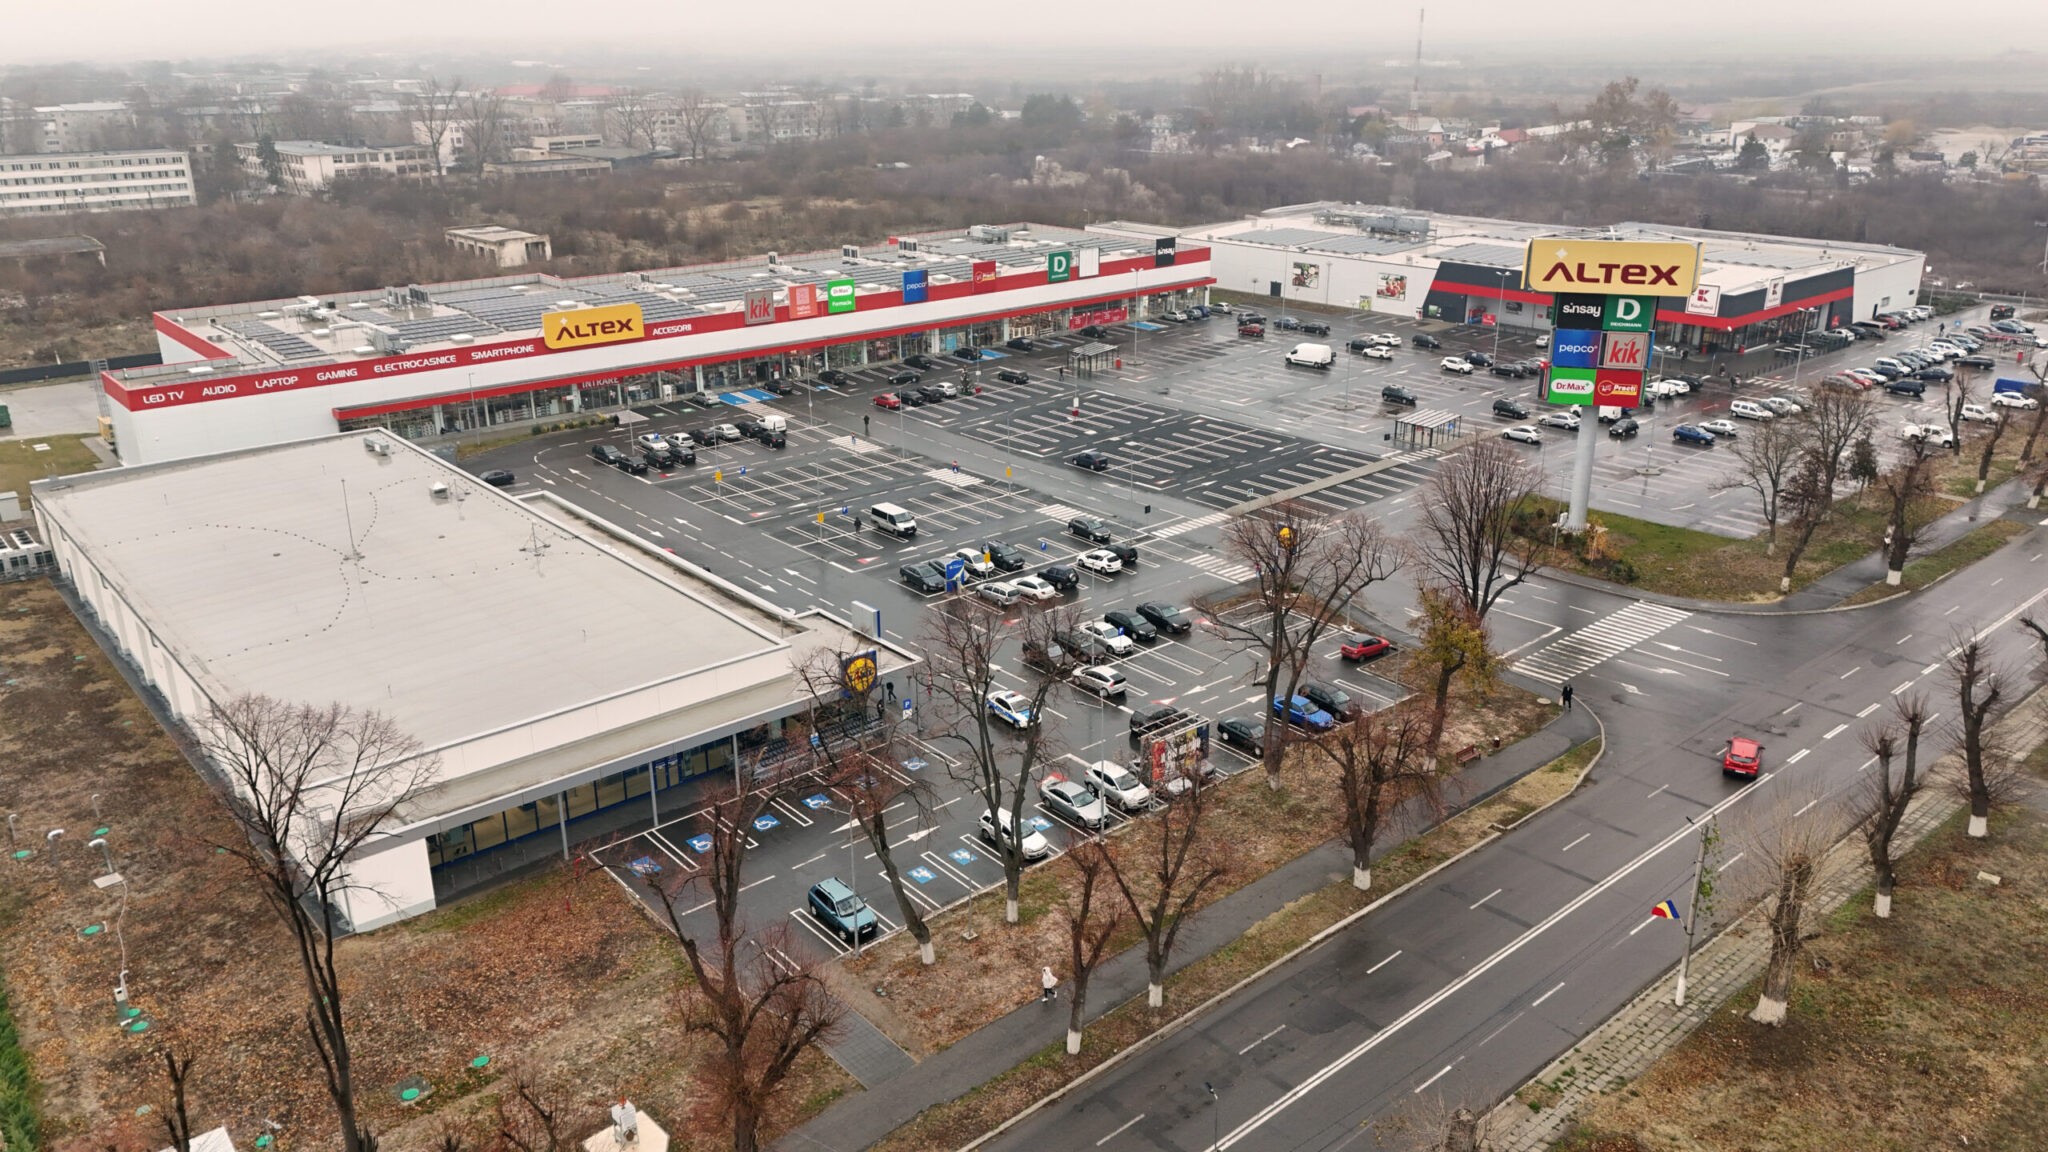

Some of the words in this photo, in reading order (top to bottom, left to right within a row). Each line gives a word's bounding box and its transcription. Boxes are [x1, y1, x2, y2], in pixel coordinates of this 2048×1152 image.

[1053, 256, 1067, 273] D
[906, 281, 926, 290] pepco
[749, 295, 771, 319] kik
[1562, 302, 1601, 317] sinsay
[1616, 298, 1641, 321] D
[652, 324, 692, 336] ACCESORII
[471, 344, 535, 360] SMARTPHONE
[1559, 344, 1594, 354] pepco
[1609, 339, 1640, 364] kik
[373, 355, 457, 374] ELECTROCASNICE
[316, 368, 358, 381] GAMING
[255, 376, 299, 389] LAPTOP
[1556, 382, 1586, 391] Dr.Max
[202, 384, 237, 396] AUDIO
[143, 393, 165, 404] LED
[167, 391, 184, 401] TV
